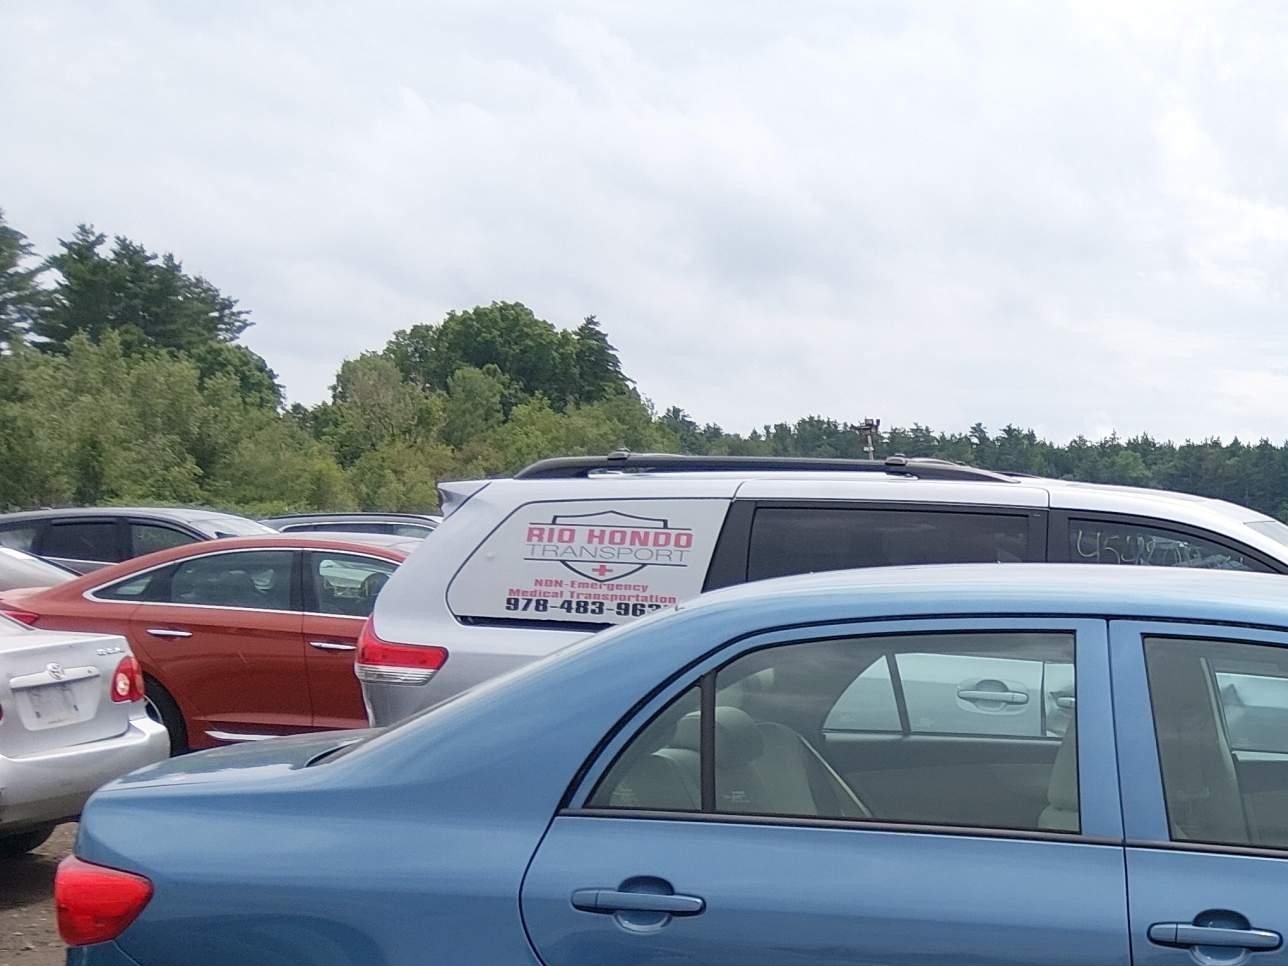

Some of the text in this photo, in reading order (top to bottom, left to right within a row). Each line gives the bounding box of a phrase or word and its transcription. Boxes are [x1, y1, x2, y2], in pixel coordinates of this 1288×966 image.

[526, 525, 694, 549] RIO HONDO
[525, 543, 690, 562] TRANSPORT
[508, 587, 677, 605] Medical Transportation
[505, 597, 668, 617] 978-483-96
